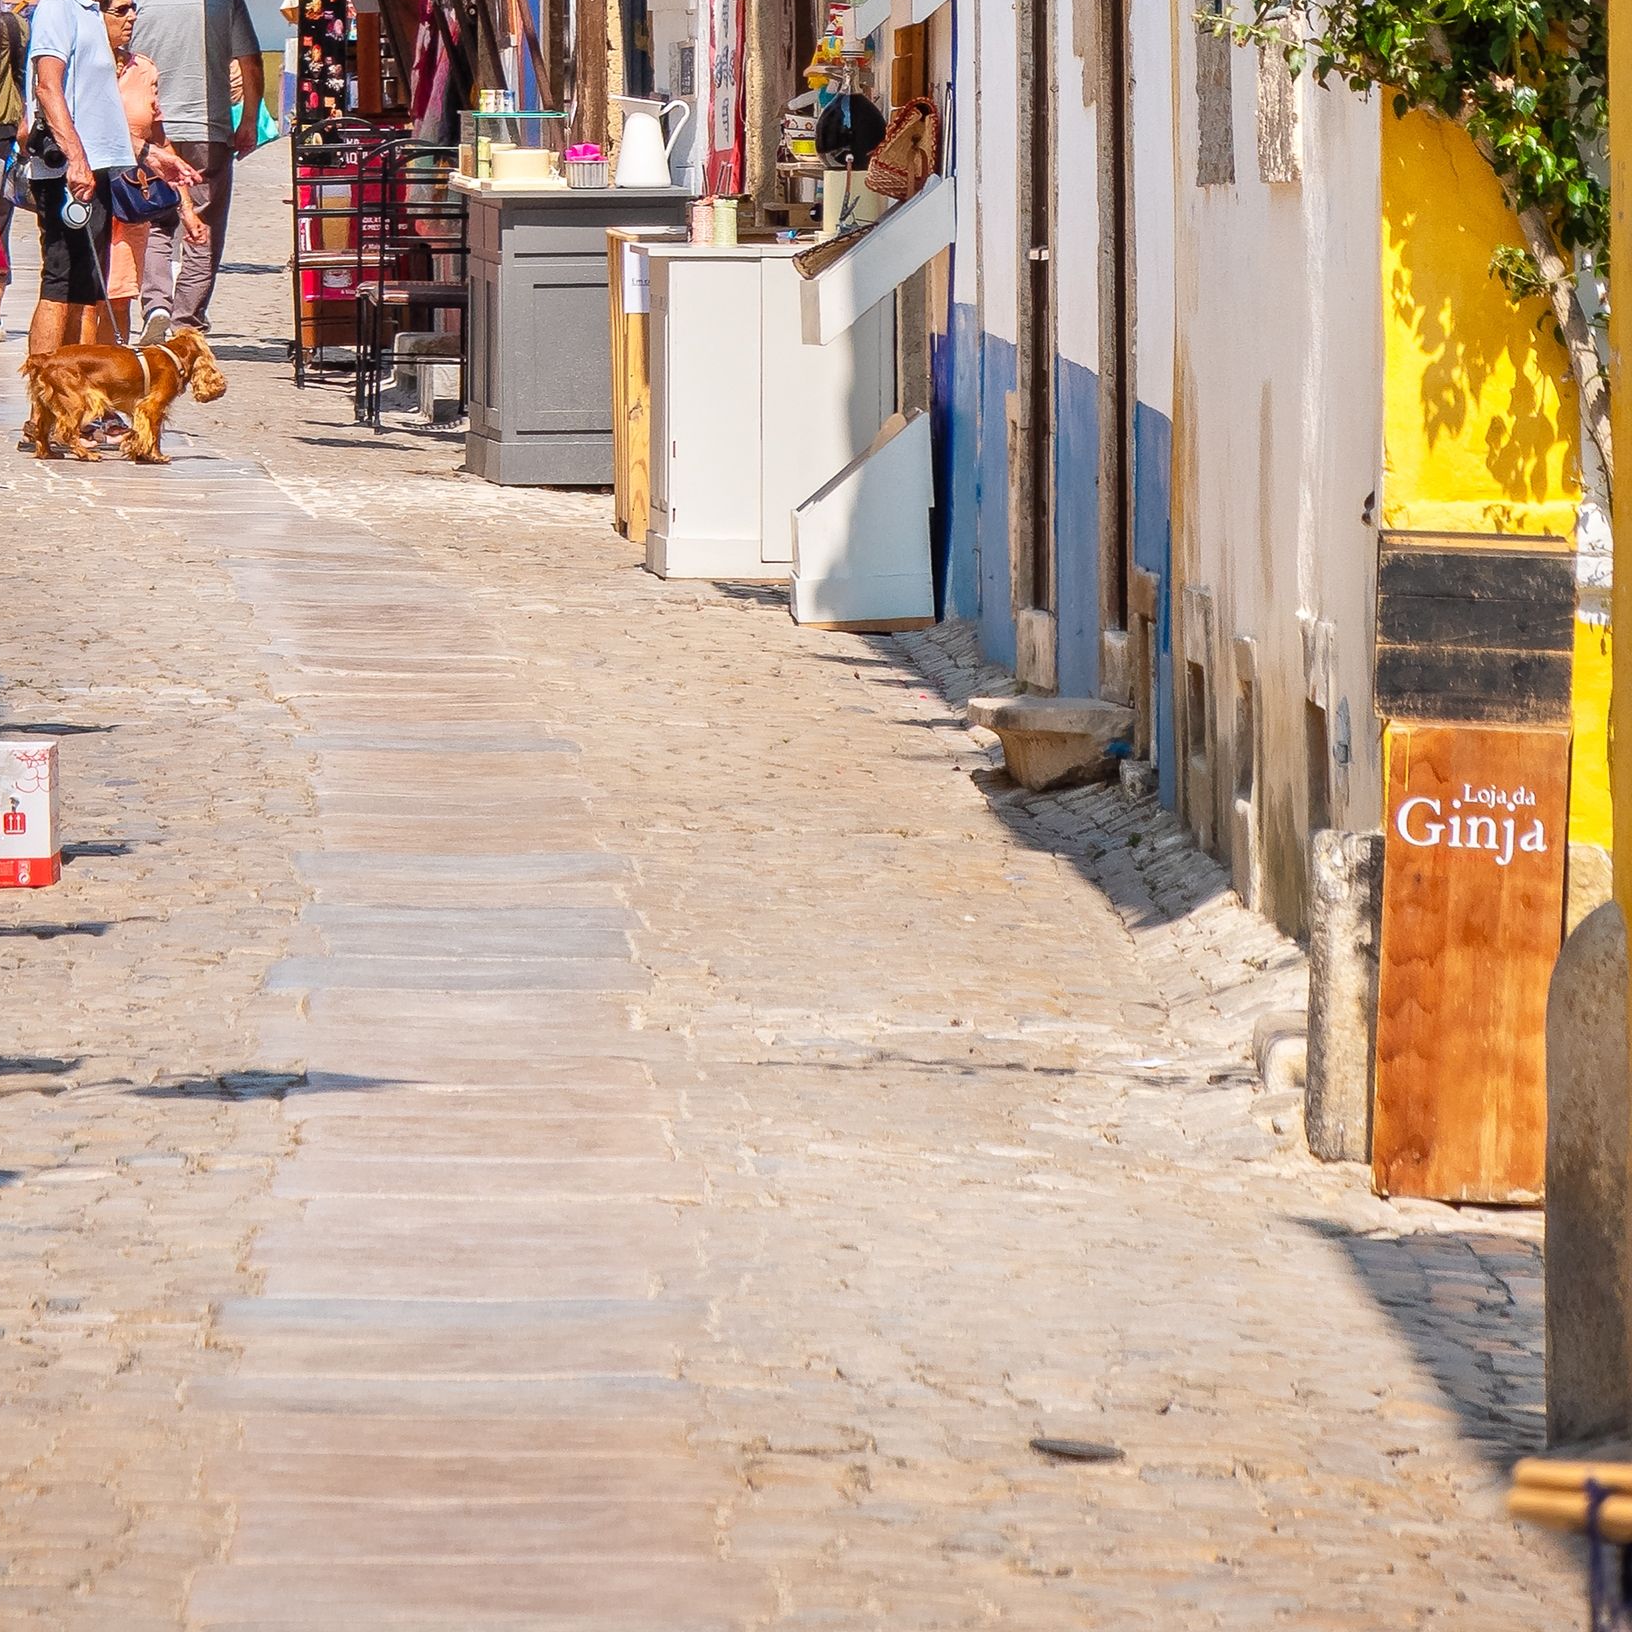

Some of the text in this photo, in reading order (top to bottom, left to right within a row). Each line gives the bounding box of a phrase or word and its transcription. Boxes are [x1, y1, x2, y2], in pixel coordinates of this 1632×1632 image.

[1463, 783, 1537, 809] Loja da
[1396, 796, 1549, 866] Ginja
